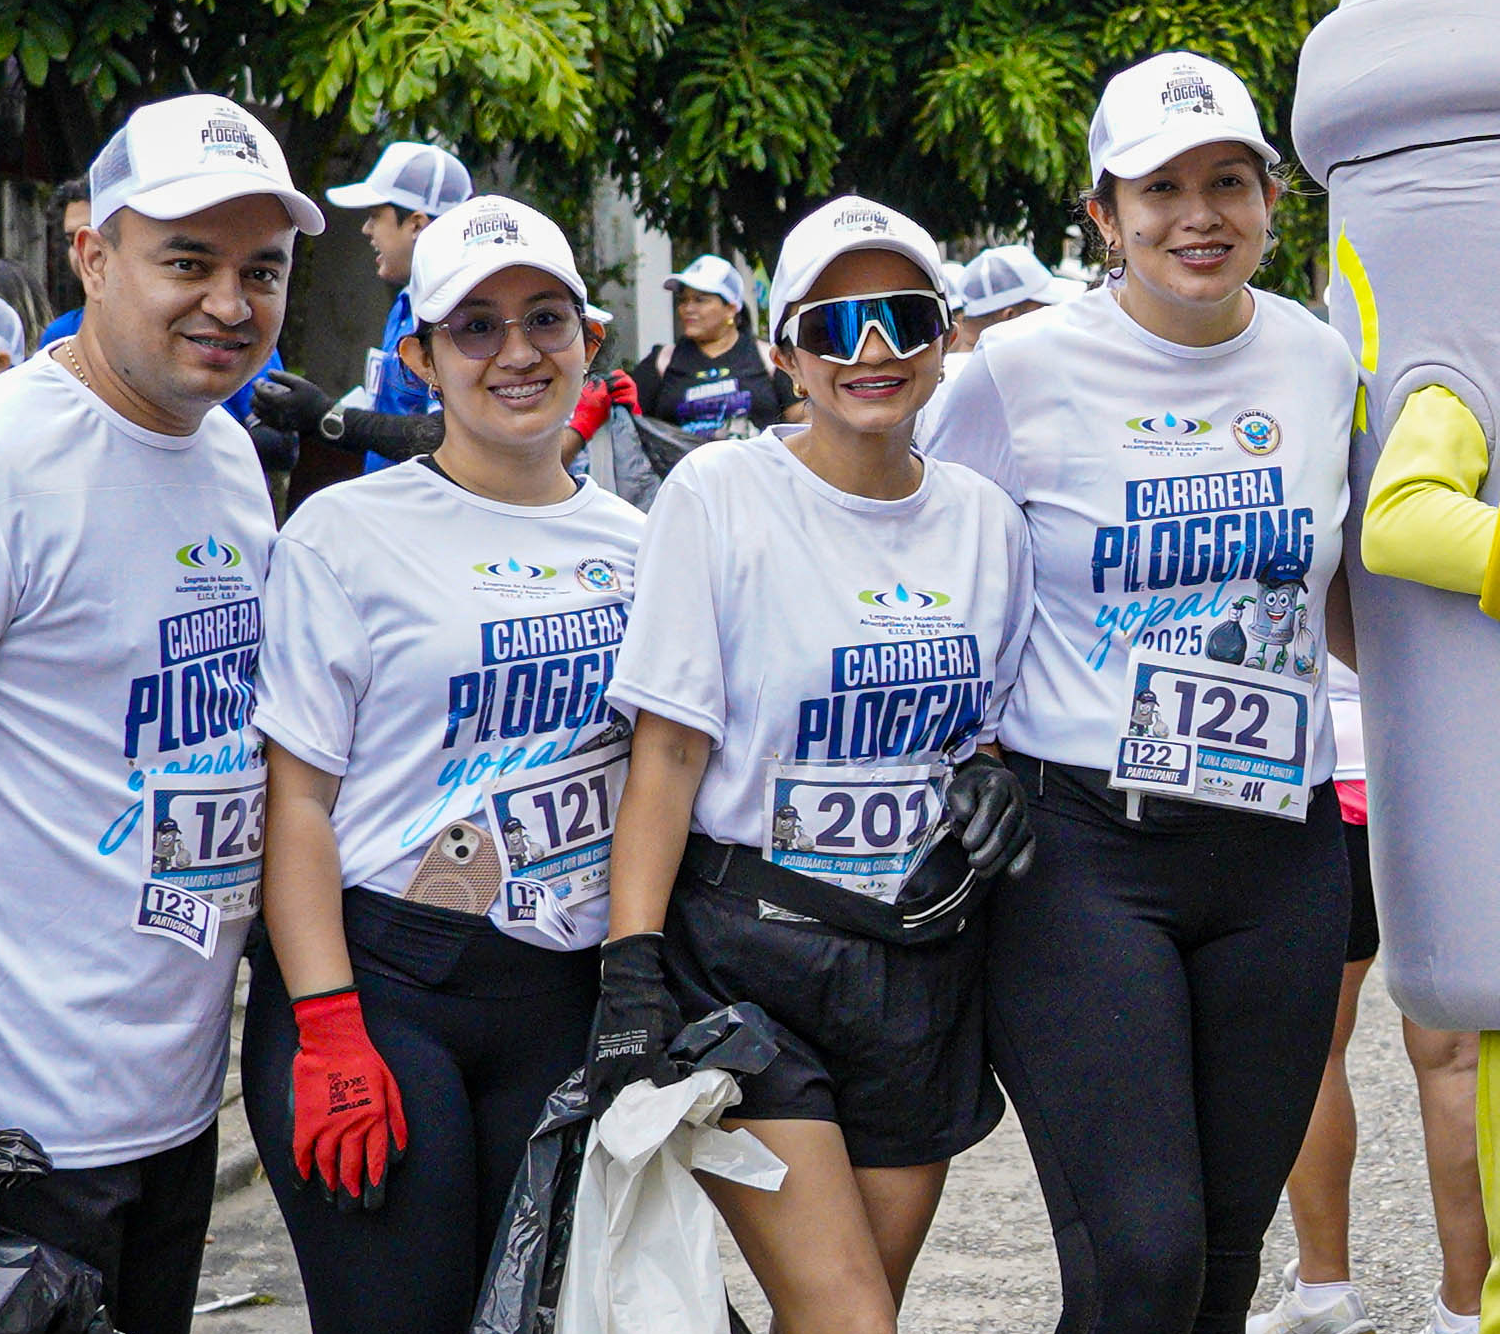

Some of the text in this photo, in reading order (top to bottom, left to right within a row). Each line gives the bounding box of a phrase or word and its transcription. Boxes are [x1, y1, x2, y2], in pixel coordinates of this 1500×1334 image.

[1136, 470, 1276, 518] CARRRERA
[1091, 507, 1314, 594] PLOGGING
[167, 601, 258, 660] CARRRERA
[492, 605, 625, 660] CARRRERA
[1142, 625, 1203, 656] 2025
[843, 637, 975, 687] CARRRERA
[125, 648, 260, 758] PLOGGI
[442, 648, 621, 749] PLOGGI
[1175, 680, 1269, 750] 122
[1125, 767, 1181, 783] PARTICIPANTE
[1130, 742, 1172, 767] 122
[1220, 756, 1250, 773] CIUDAD
[532, 774, 610, 849] 121
[1240, 781, 1266, 803] 4K
[196, 791, 266, 860] 123
[781, 855, 833, 870] ¡CORRAMOS
[834, 860, 853, 871] POR
[854, 861, 871, 873] UNA
[149, 914, 201, 941] PARTICIPANTE
[155, 889, 196, 921] 123
[596, 1043, 647, 1062] Titanium
